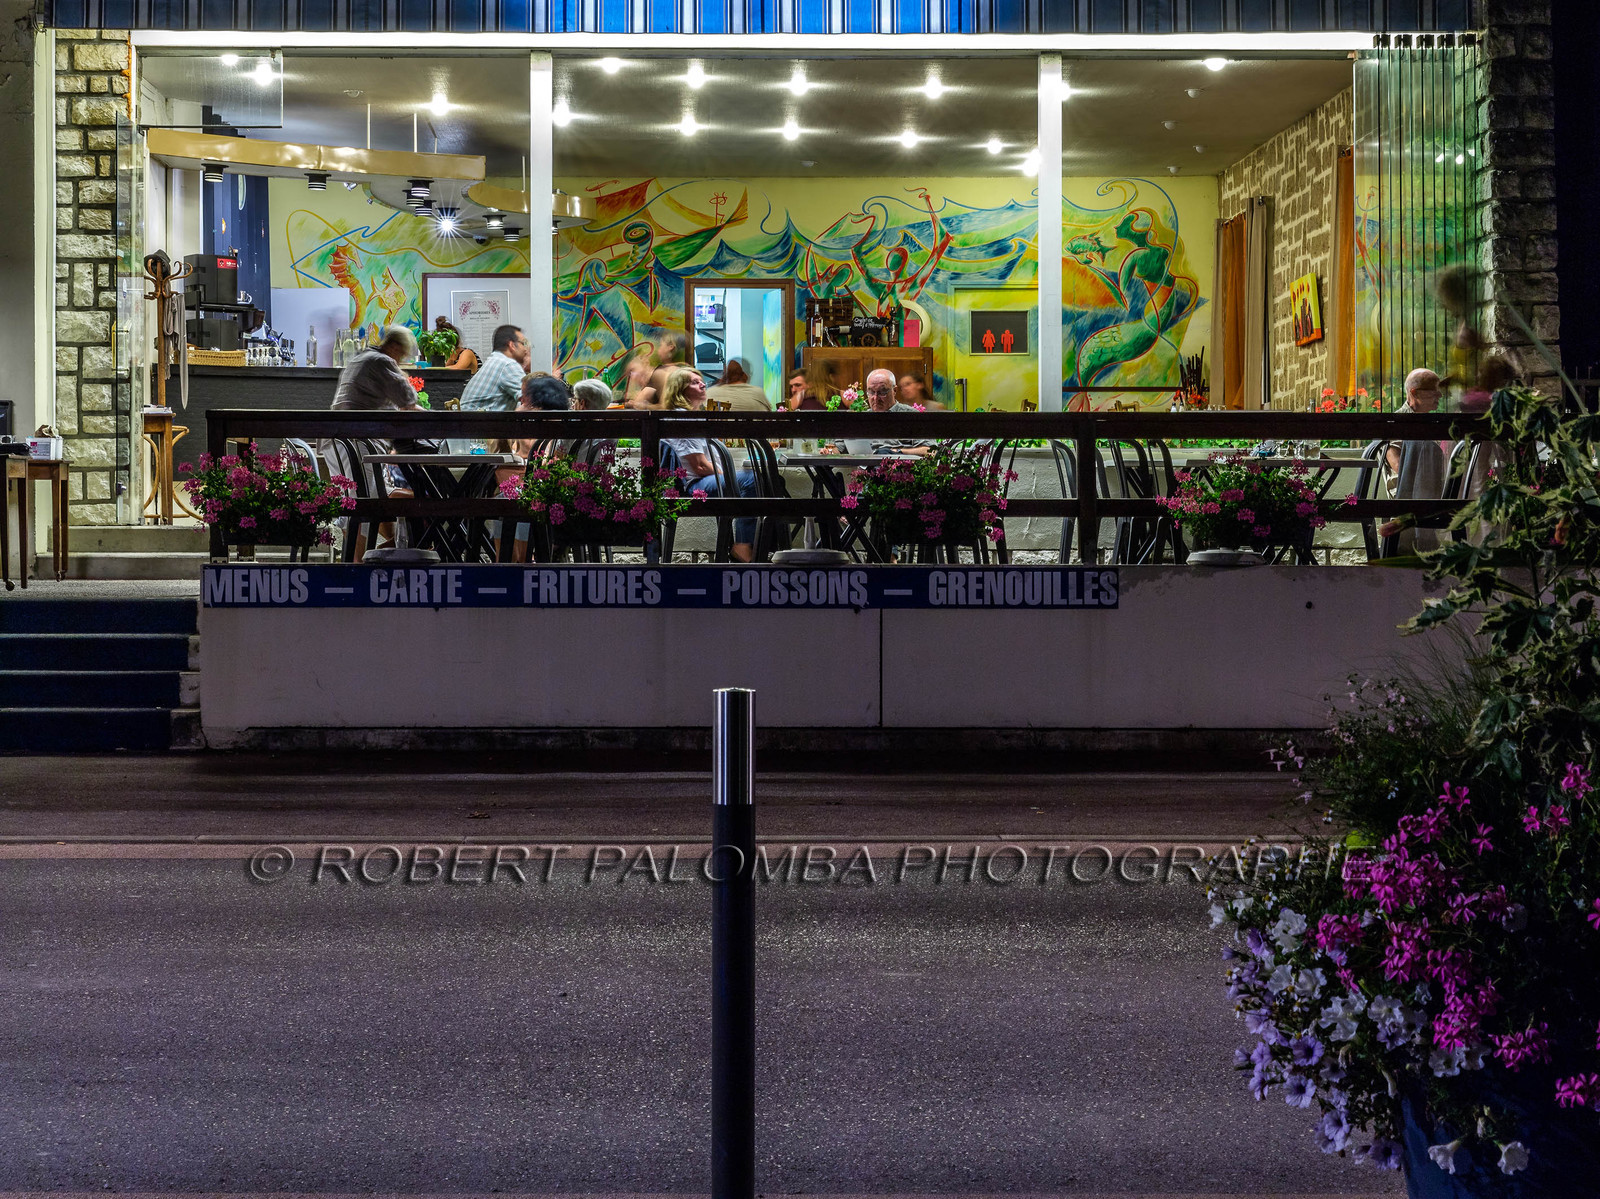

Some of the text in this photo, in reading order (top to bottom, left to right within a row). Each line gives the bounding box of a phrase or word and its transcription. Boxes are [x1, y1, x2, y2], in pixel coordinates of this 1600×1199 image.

[204, 568, 309, 604] MENUS
[369, 568, 463, 604] CARTE
[523, 568, 662, 605] FRITURES
[721, 569, 869, 607] POISSONS
[928, 569, 1119, 606] GRENOUILLES
